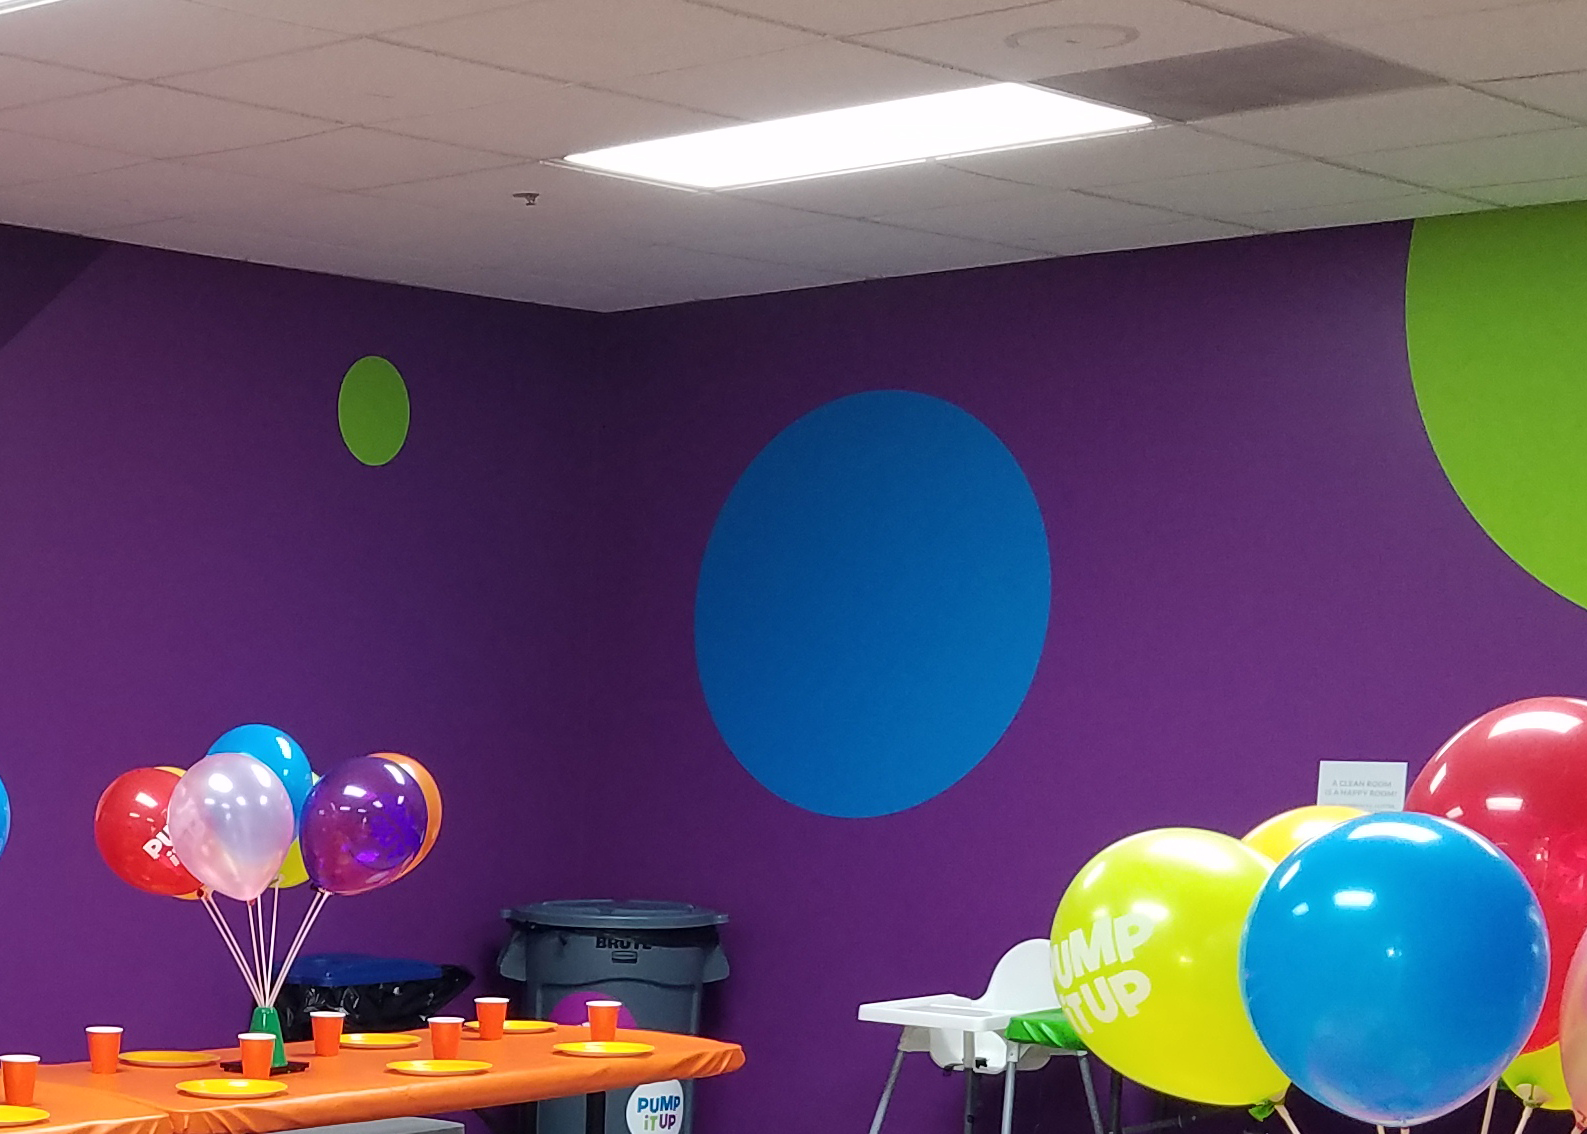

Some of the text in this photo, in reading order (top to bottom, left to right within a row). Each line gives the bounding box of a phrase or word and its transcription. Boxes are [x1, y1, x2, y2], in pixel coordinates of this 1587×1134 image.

[1332, 779, 1338, 787] A
[1366, 780, 1392, 788] ROOM
[142, 824, 173, 860] PU
[1051, 913, 1154, 989] UMP
[1079, 969, 1152, 1024] UP
[637, 1095, 681, 1113] PUMP
[659, 1113, 676, 1130] UP
